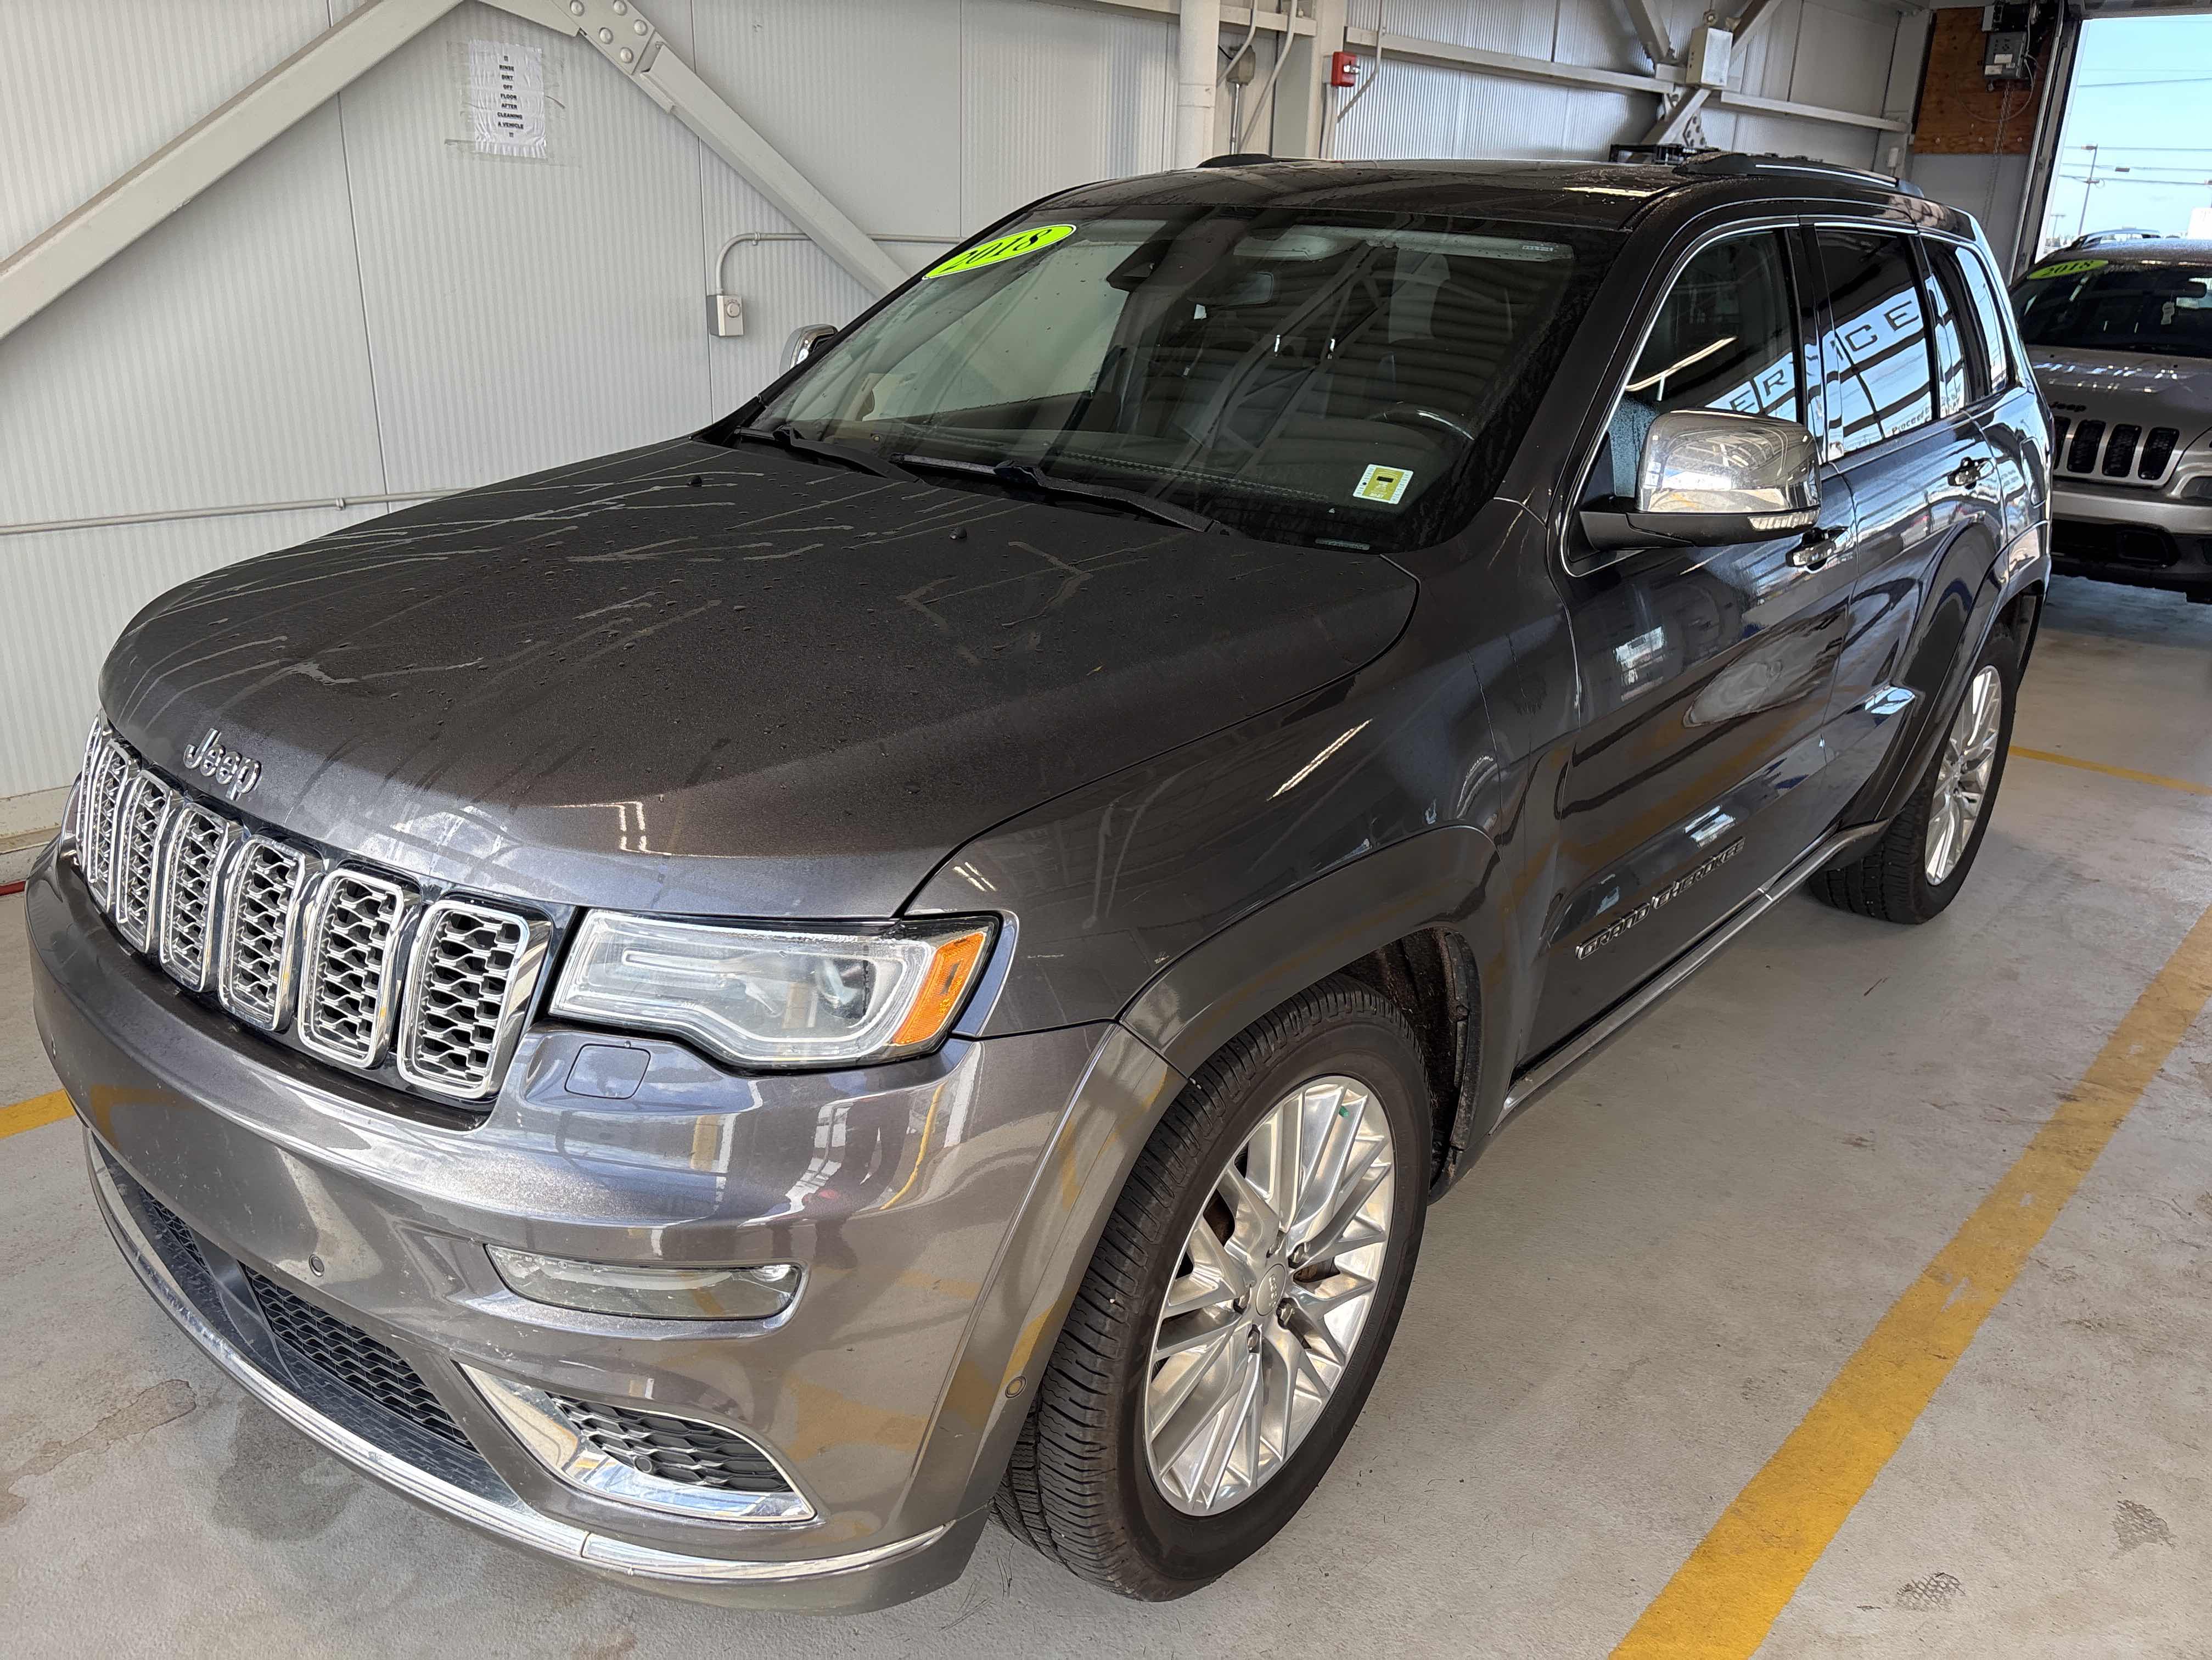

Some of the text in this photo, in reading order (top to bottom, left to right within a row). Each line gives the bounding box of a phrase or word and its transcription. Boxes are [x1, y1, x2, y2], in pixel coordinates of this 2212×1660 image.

[183, 727, 262, 800] Jeep
[1575, 835, 1746, 960] GRAND CHEROKEE
